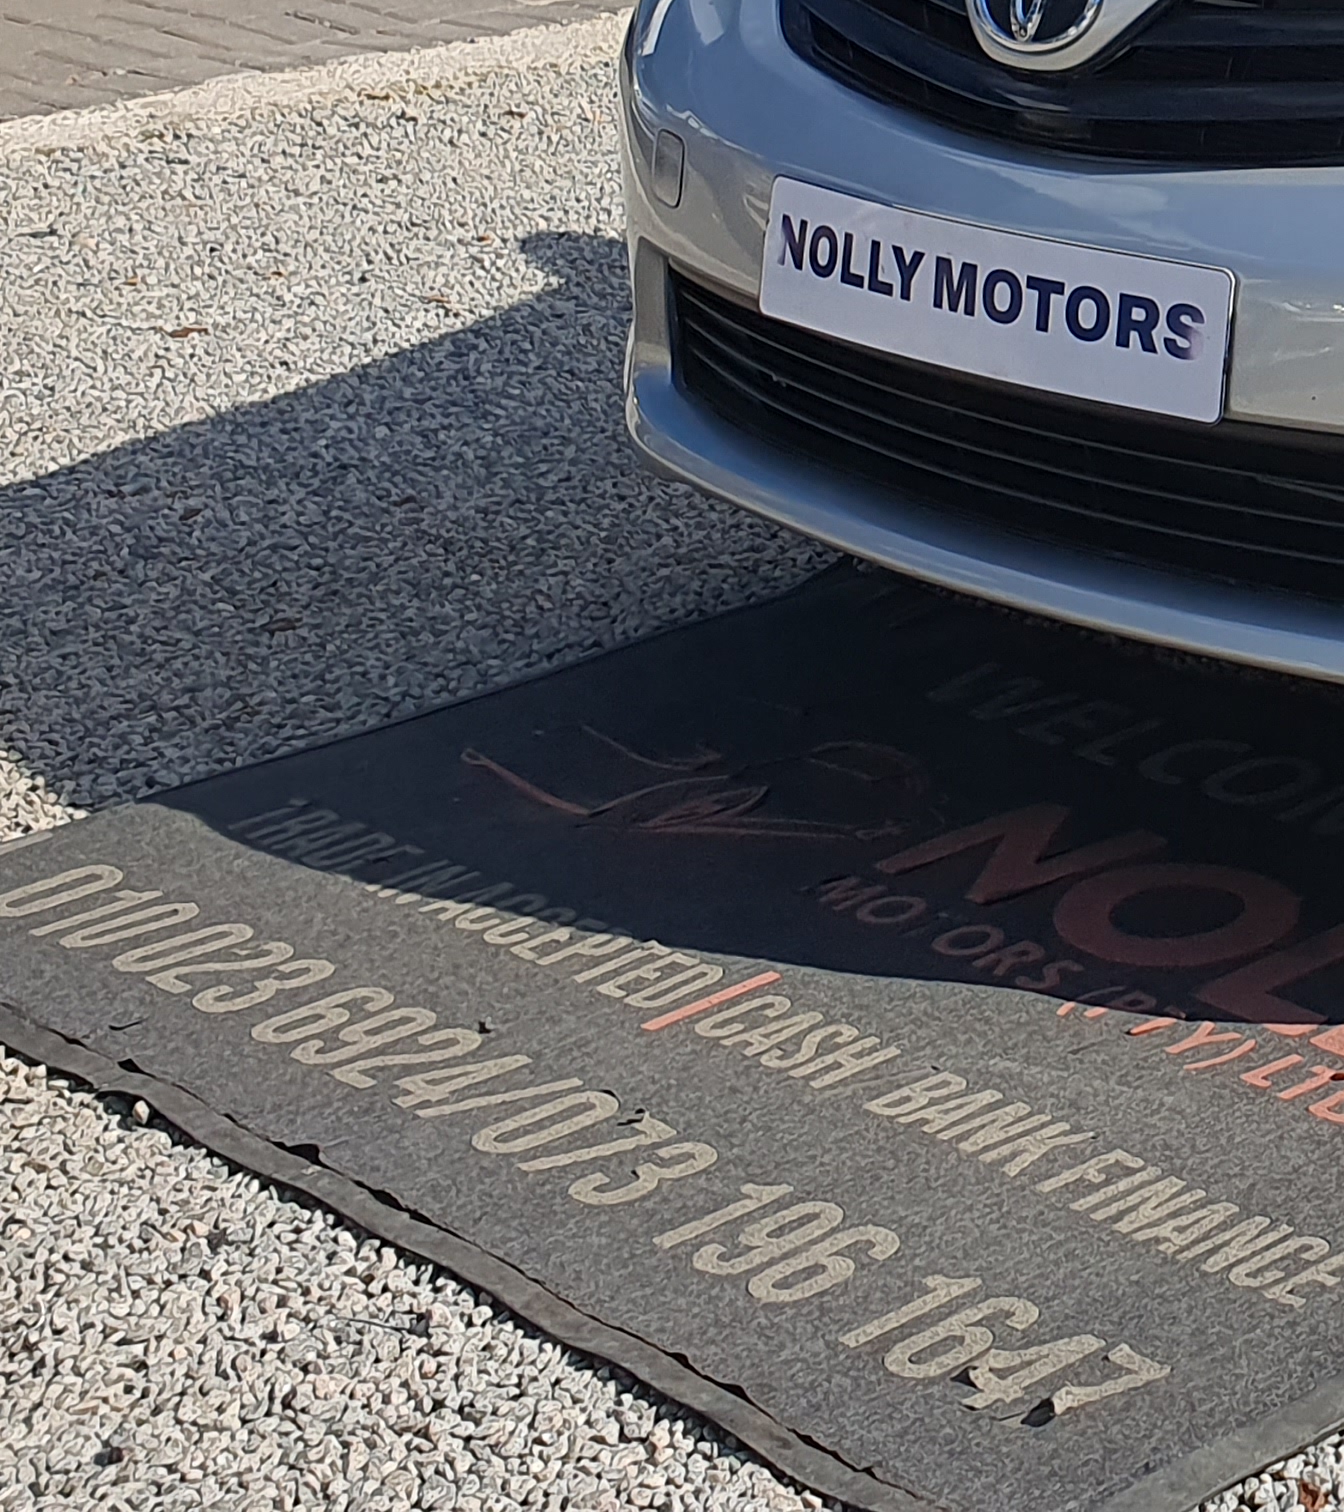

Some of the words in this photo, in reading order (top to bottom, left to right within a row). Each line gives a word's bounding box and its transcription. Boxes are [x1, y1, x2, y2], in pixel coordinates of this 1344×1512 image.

[777, 213, 925, 302] NOLLY
[932, 255, 1206, 361] MOTORS
[819, 875, 1085, 989] MOORS
[418, 882, 724, 1009] ACCEPTED
[694, 995, 901, 1089] CASH
[862, 1066, 1095, 1176] BANK
[652, 1183, 901, 1303] 196
[838, 1274, 1173, 1414] 1647
